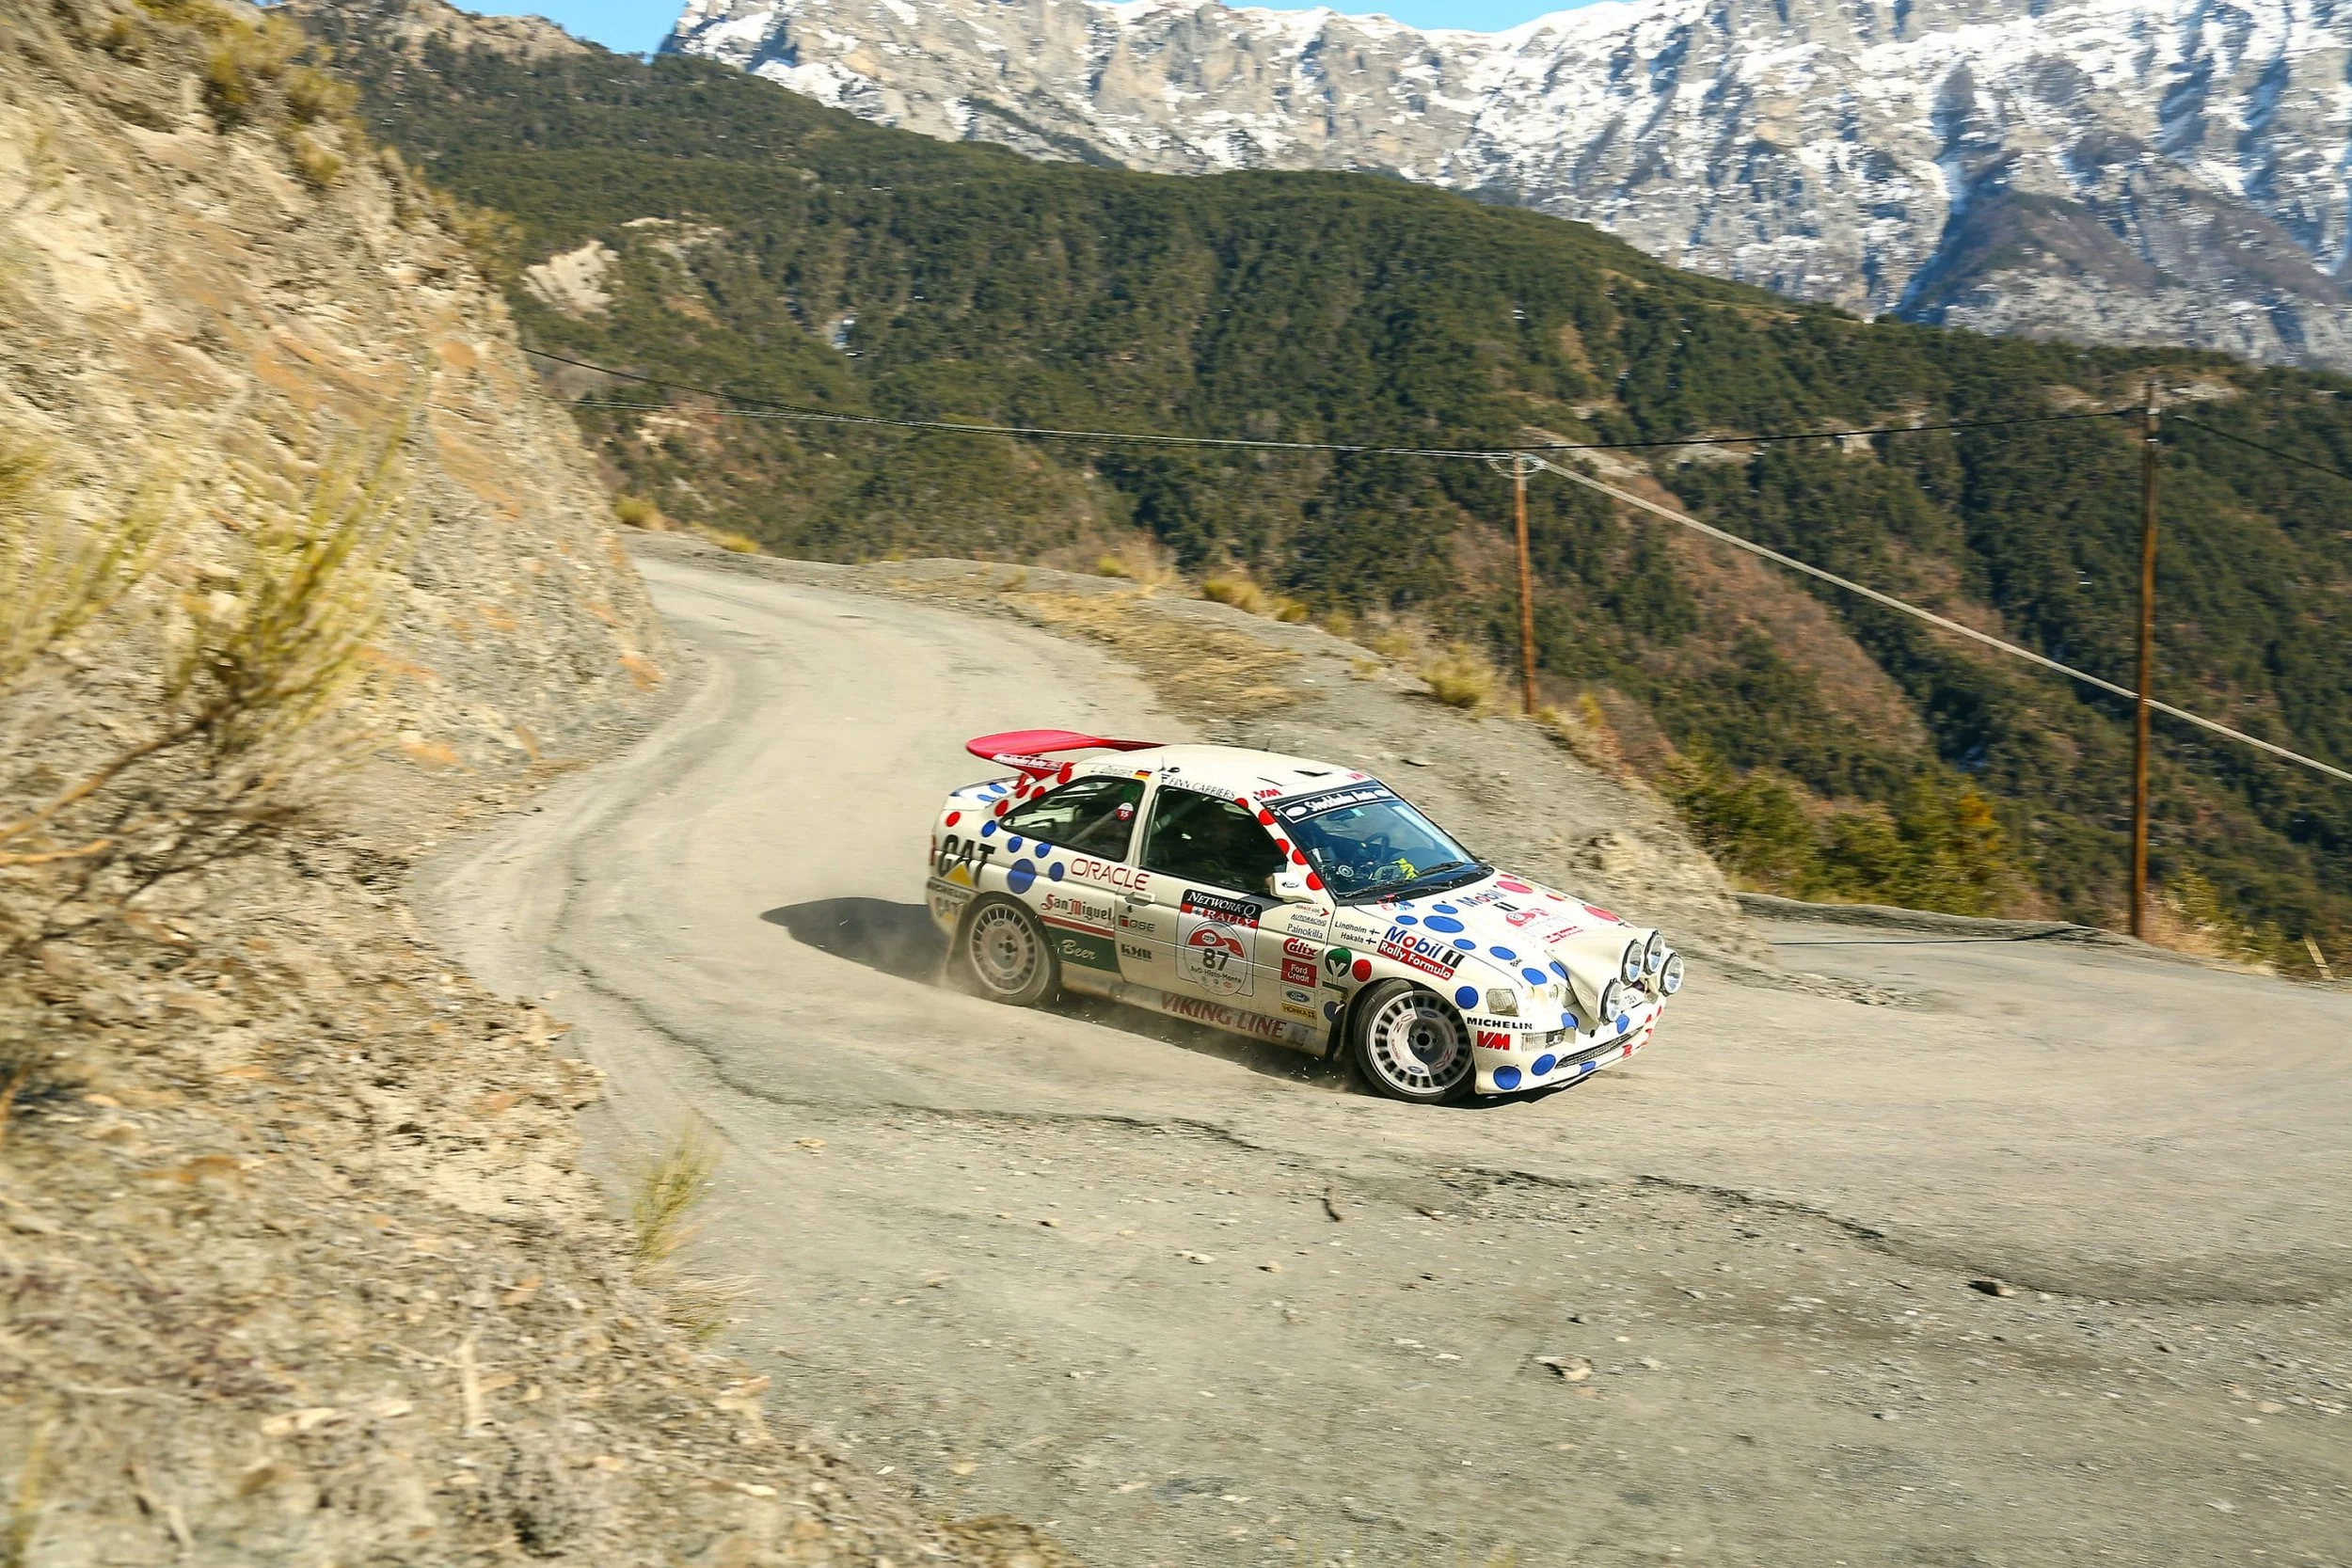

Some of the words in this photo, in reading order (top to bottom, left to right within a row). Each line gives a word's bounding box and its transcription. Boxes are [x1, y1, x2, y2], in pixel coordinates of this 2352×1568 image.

[1169, 777, 1191, 788] FINN
[1193, 782, 1236, 800] CARRIERS
[937, 834, 996, 888] CAT
[1071, 858, 1151, 891] ORACLE
[1041, 894, 1069, 911] San
[1067, 898, 1113, 921] Miguel
[1187, 892, 1244, 913] NETWORK
[1242, 905, 1257, 918] Q
[1455, 889, 1507, 908] Mobil
[1206, 909, 1256, 927] RALLY
[1334, 921, 1367, 934] Lindholm
[1341, 932, 1364, 943] Hakala
[1384, 926, 1444, 959] Mobil
[1061, 939, 1097, 959] Beer
[1203, 948, 1230, 972] 87
[1283, 938, 1318, 960] Calix
[1290, 963, 1308, 974] Ford
[1379, 942, 1406, 961] Rally
[1407, 954, 1452, 979] Formula
[1287, 971, 1310, 983] Credit
[1161, 992, 1233, 1026] VIKING
[1237, 1010, 1287, 1038] LINE
[1466, 1017, 1533, 1030] MICHELIN
[1476, 1031, 1511, 1052] VM
